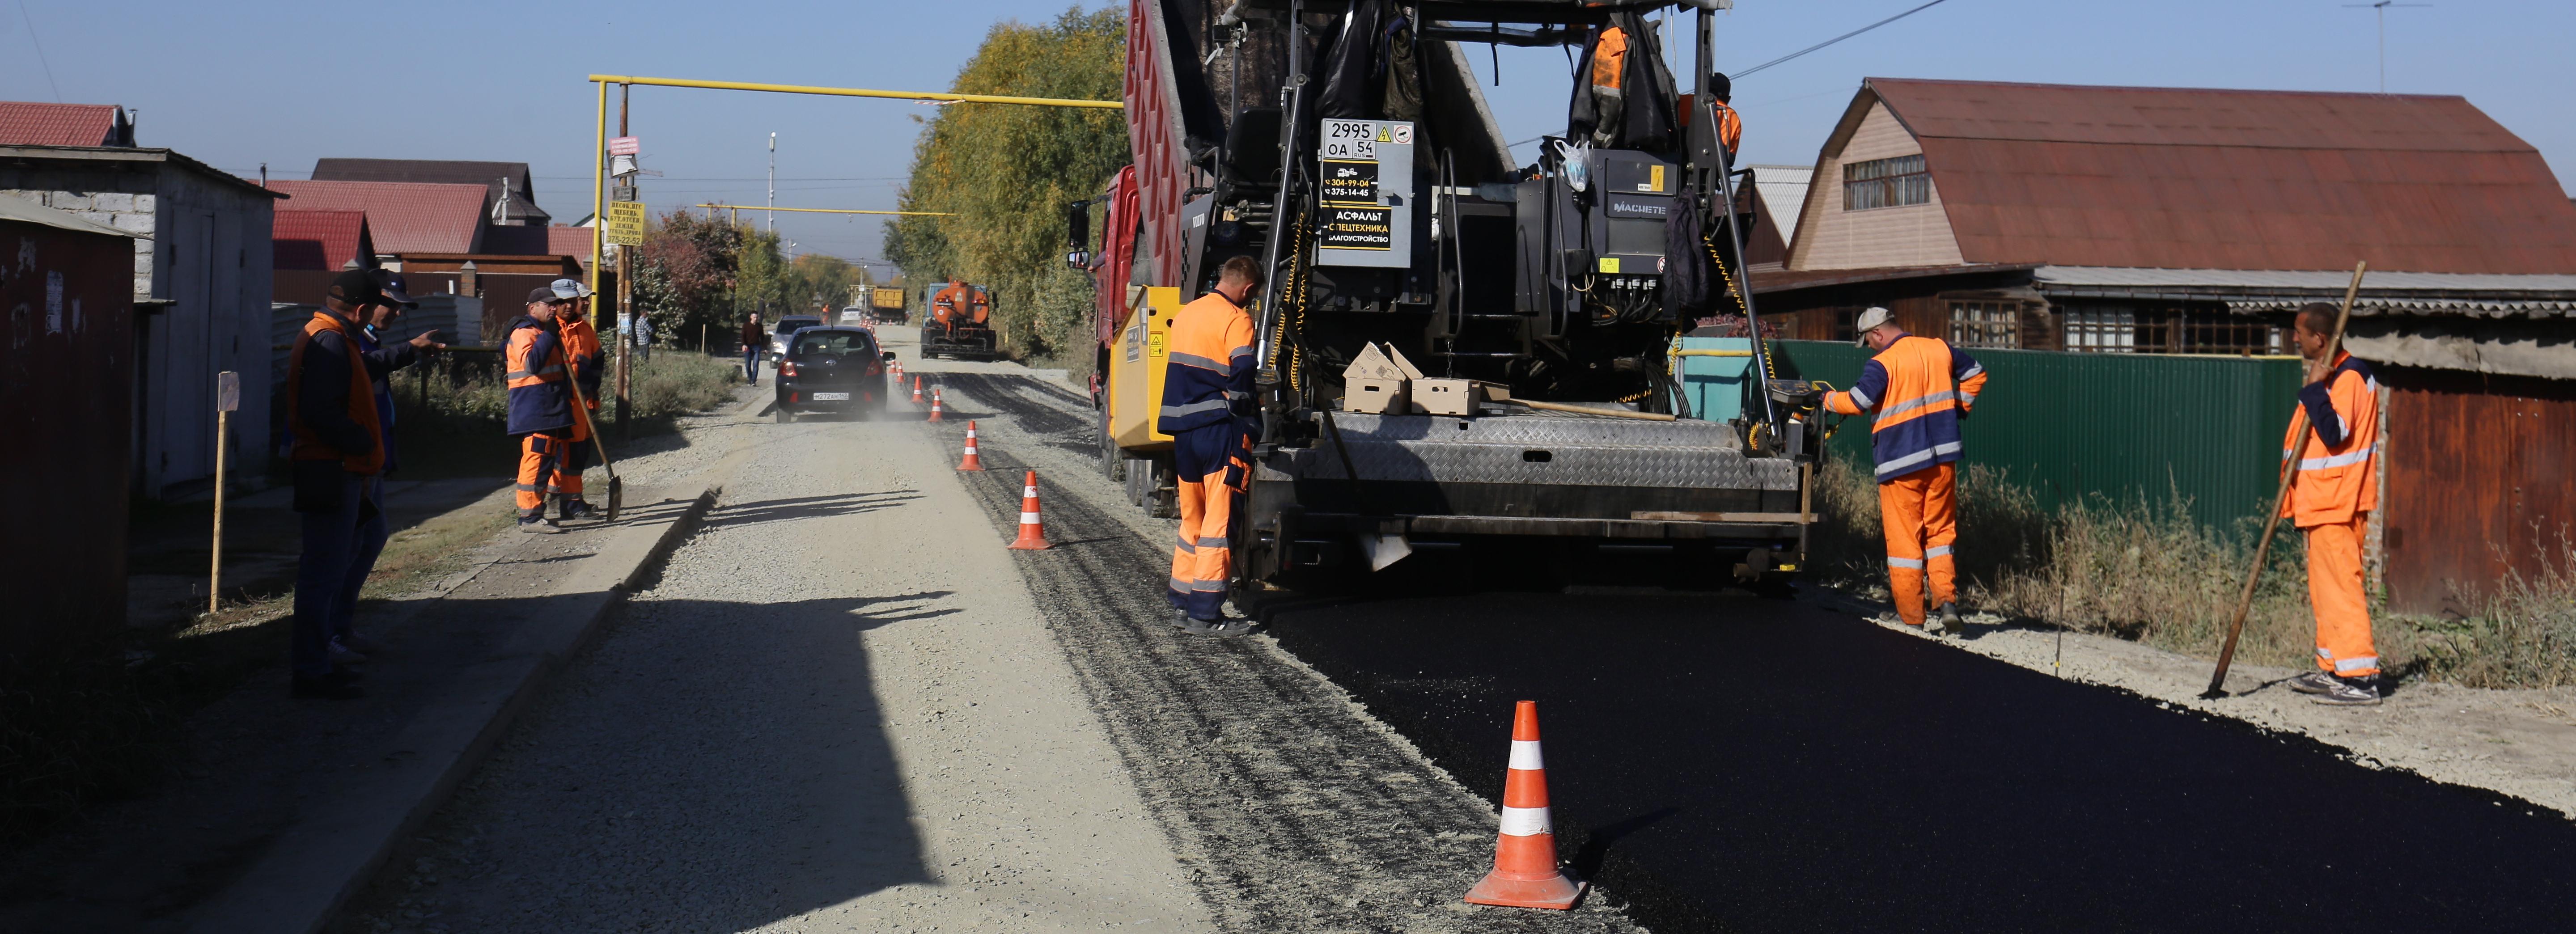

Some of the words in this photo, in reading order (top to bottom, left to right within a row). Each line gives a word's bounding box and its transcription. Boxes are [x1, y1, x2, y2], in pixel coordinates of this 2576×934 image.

[1331, 123, 1370, 139] 2995
[1357, 141, 1372, 153] 54
[1331, 179, 1369, 187] 304-99-04
[1331, 188, 1368, 196] 375-14-45
[1614, 201, 1666, 215] MACHETE
[1336, 211, 1382, 221] АСФАЛЬТ
[1329, 223, 1388, 232] СПЕЦТЕХНИКА
[607, 236, 640, 245] 375-22-52
